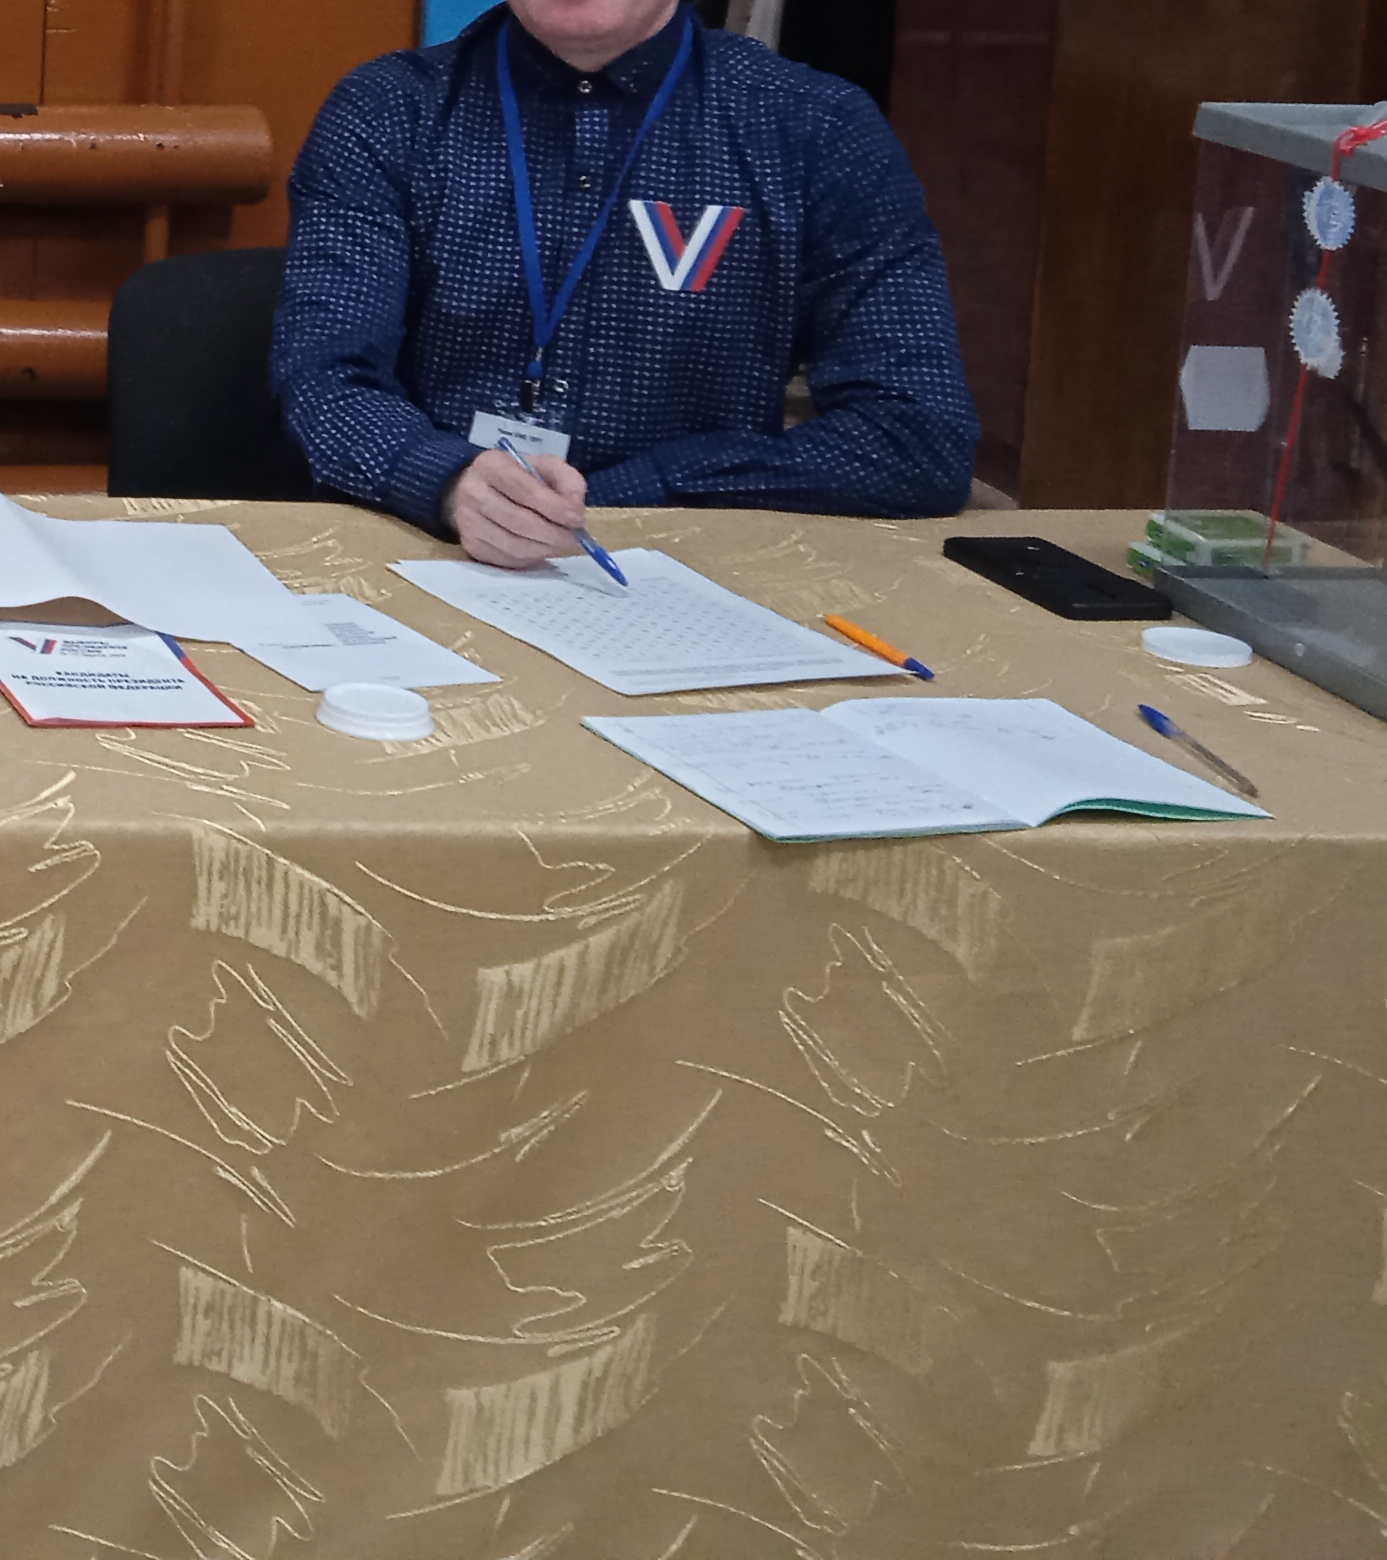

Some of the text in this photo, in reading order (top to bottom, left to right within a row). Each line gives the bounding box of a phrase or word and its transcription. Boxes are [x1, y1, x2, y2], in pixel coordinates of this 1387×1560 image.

[55, 670, 130, 678] КАНДИДАТЫ
[31, 675, 106, 684] ДОЛЖНОСТЬ
[107, 677, 185, 685] ПРЕЗИДЕНТА
